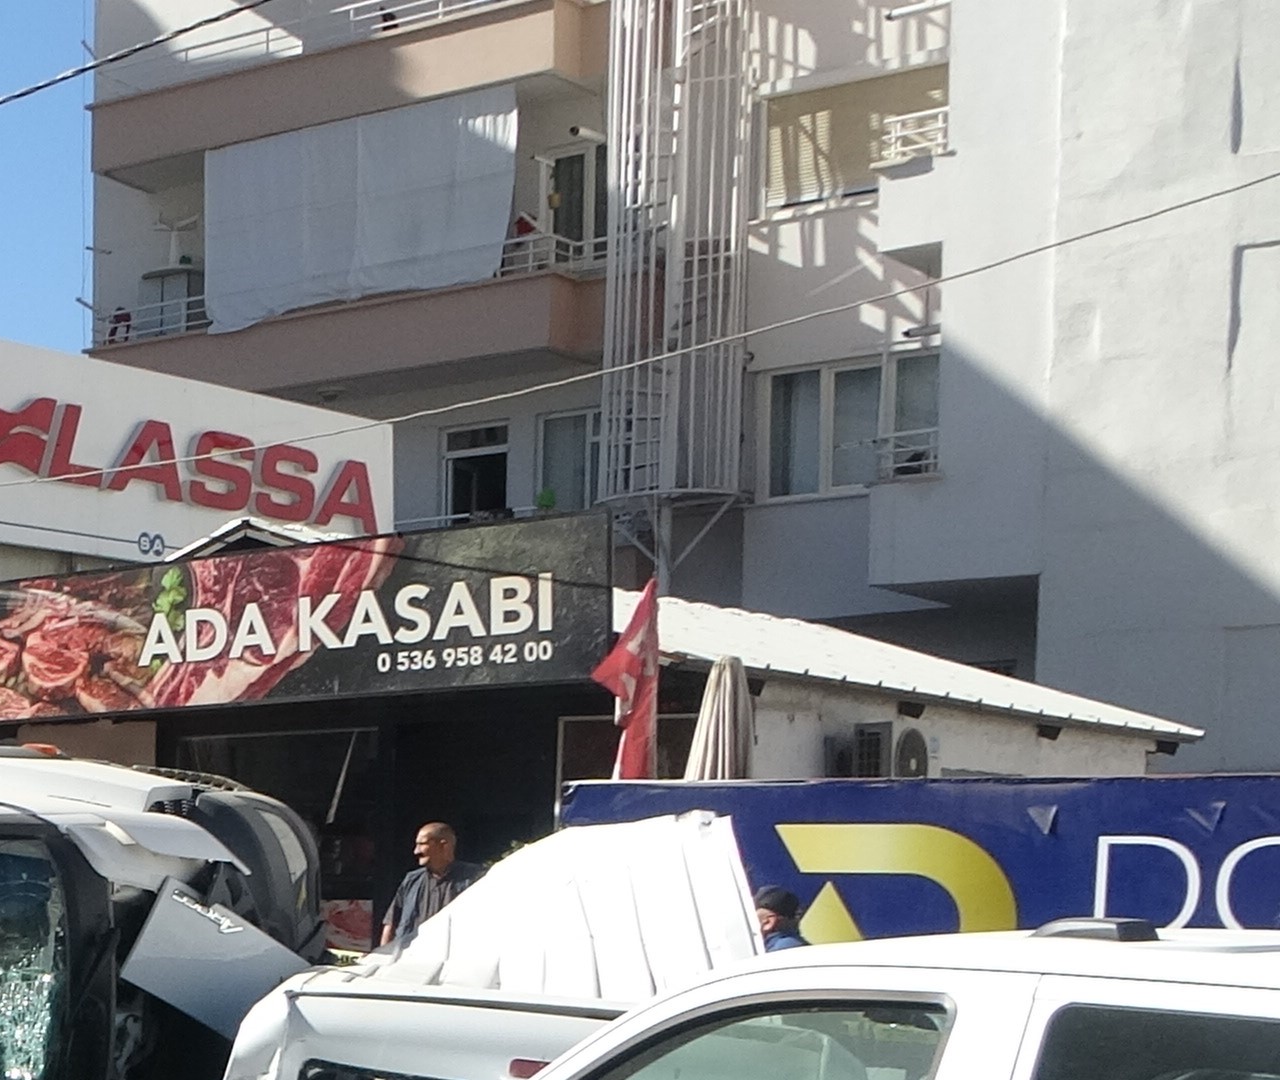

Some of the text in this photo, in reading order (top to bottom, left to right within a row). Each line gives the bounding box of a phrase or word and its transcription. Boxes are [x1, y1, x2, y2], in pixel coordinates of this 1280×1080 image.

[46, 403, 378, 535] LASSA
[137, 573, 553, 668] ADA KASABI
[376, 640, 553, 673] 0 536 958 42 00
